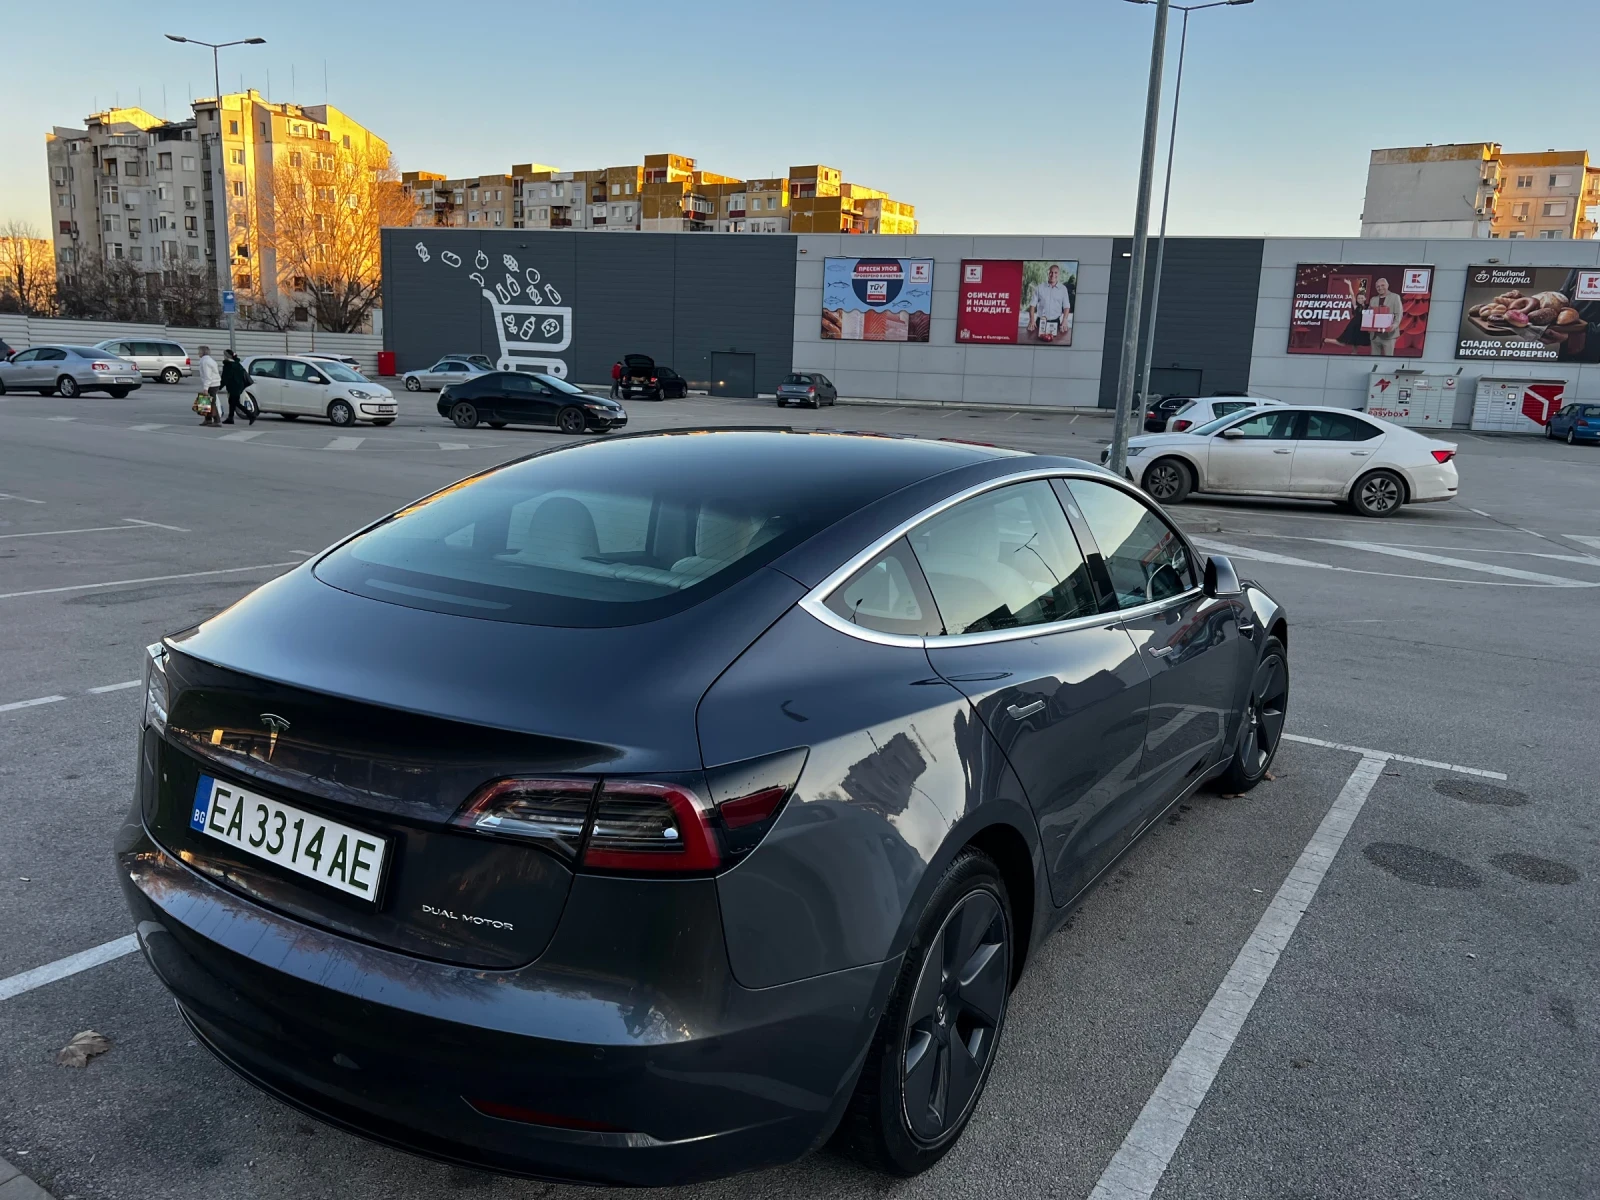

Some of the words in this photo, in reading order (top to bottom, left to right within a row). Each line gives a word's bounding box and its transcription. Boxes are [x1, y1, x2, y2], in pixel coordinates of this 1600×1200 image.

[1490, 276, 1531, 285] пекарна
[1295, 300, 1352, 309] ПРЕКРАСНА
[1294, 309, 1350, 321] КОЛЕДА
[1460, 340, 1502, 349] СЛАДКО.
[1500, 350, 1558, 358] ПРОВЕРЕНО.
[194, 808, 206, 824] BG
[422, 904, 458, 920] DUAL
[462, 914, 514, 931] MOTOR
